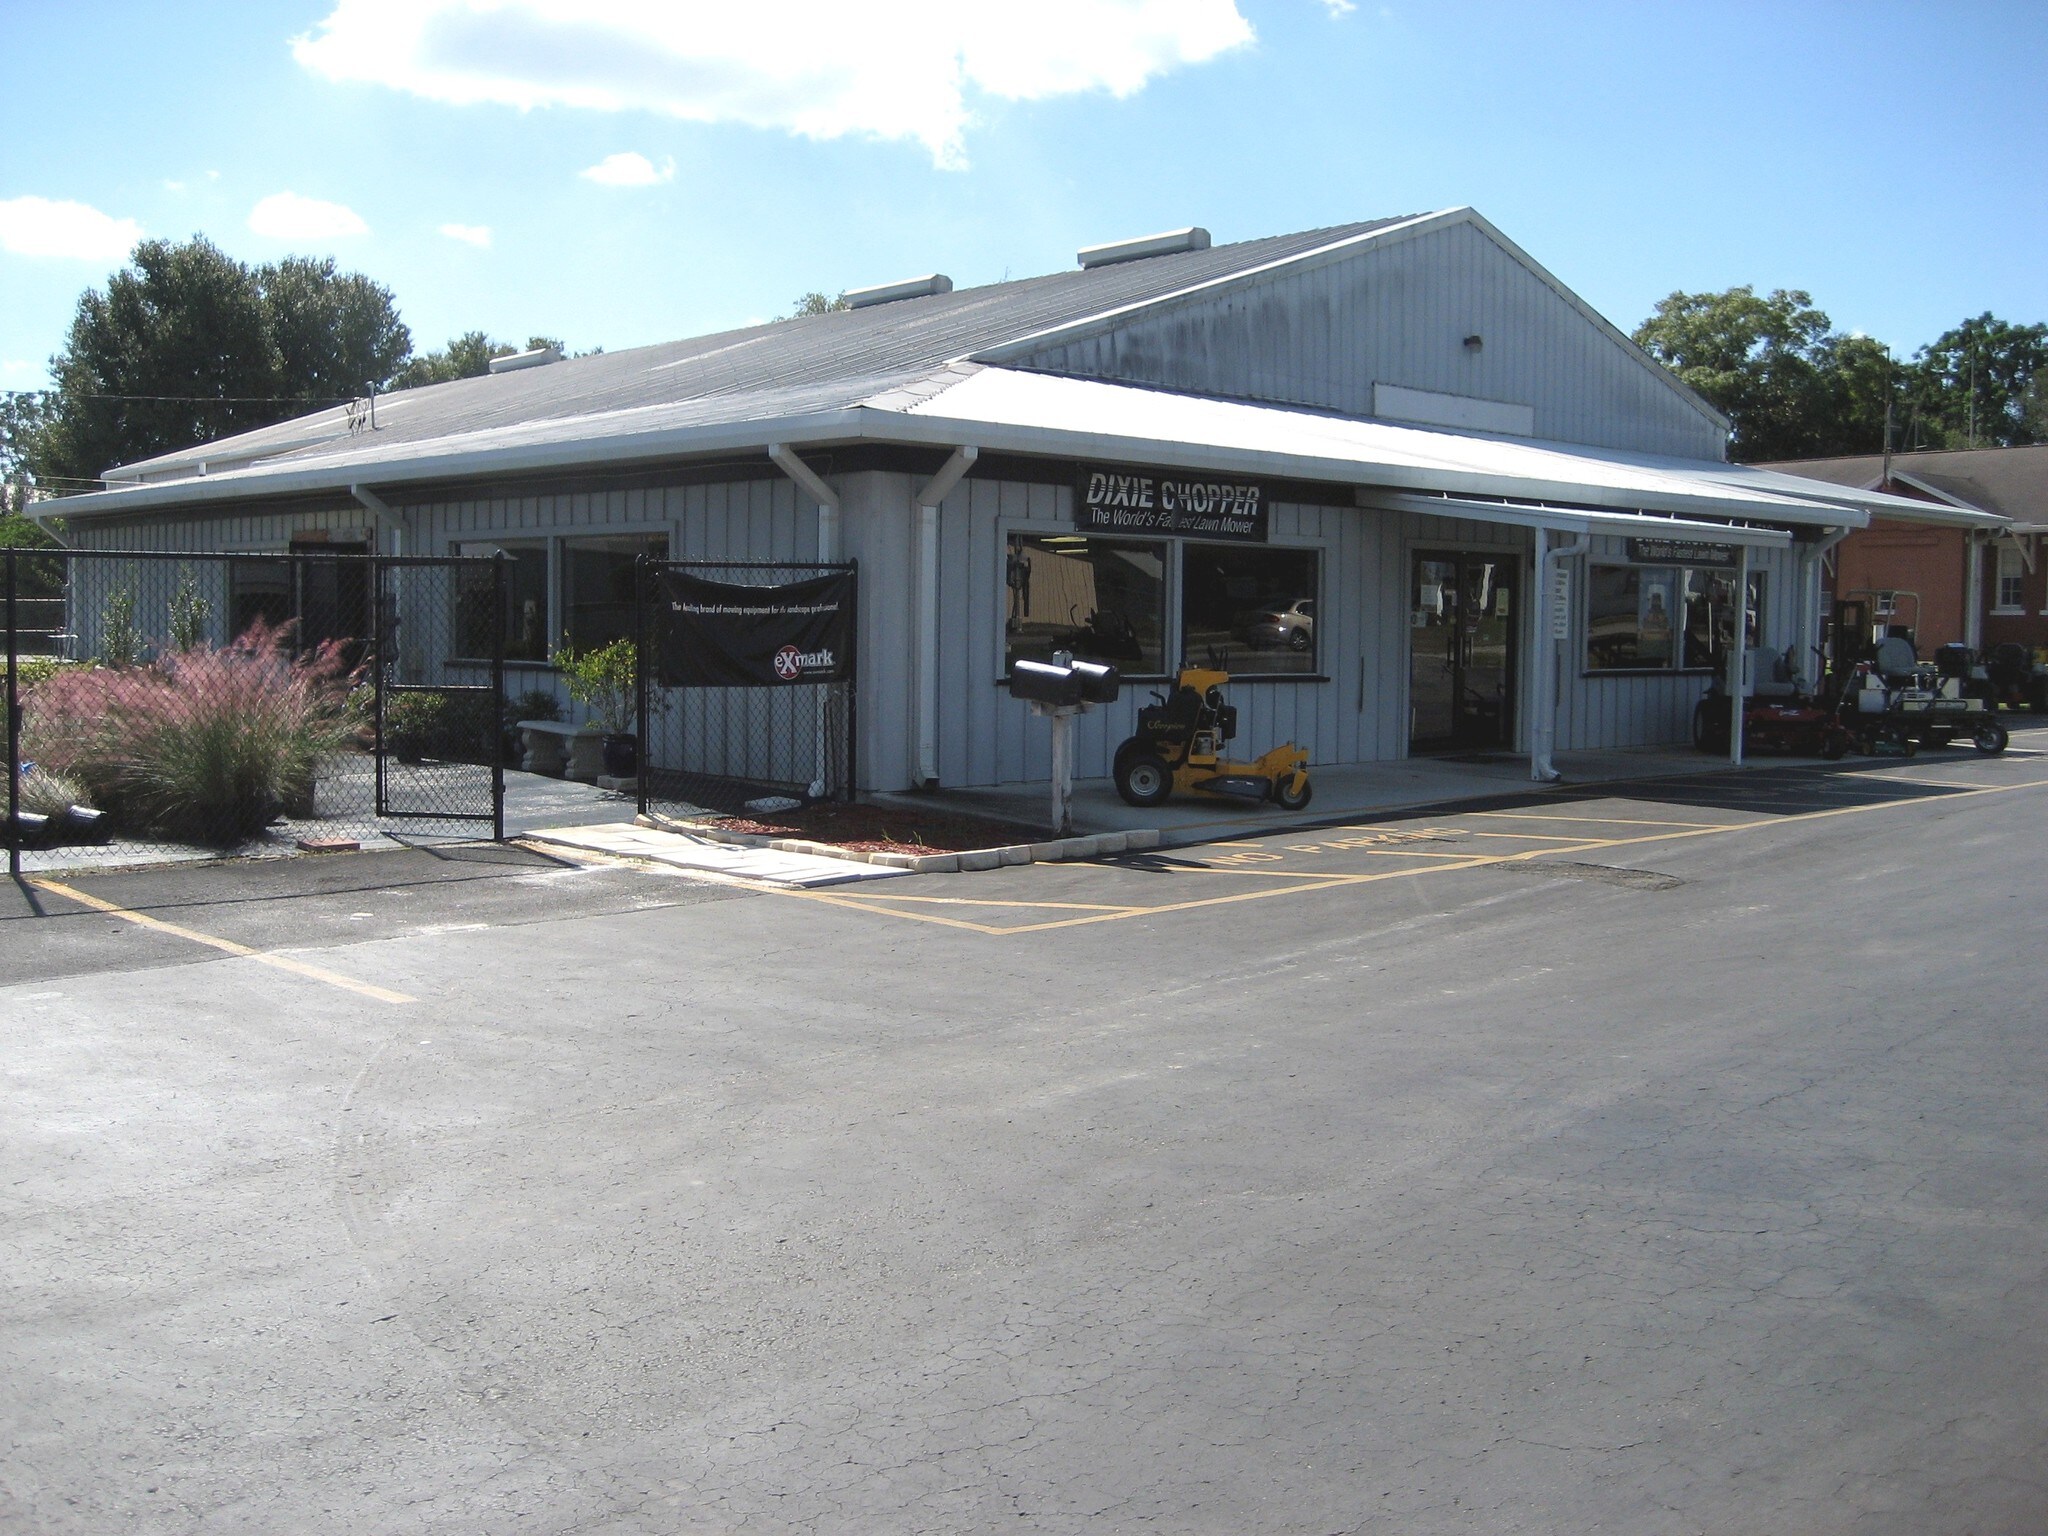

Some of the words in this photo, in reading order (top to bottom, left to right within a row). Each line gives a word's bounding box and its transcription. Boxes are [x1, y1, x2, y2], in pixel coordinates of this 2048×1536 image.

[1086, 472, 1154, 508] DIXIE
[1161, 481, 1260, 516] CHOPPER
[1091, 507, 1110, 525] The
[1113, 509, 1155, 527] World's
[1155, 512, 1195, 529] Faest
[1193, 515, 1219, 531] Lawn
[1220, 518, 1254, 534] Mower
[1198, 852, 1284, 867] NO
[1283, 827, 1470, 854] PARKING
